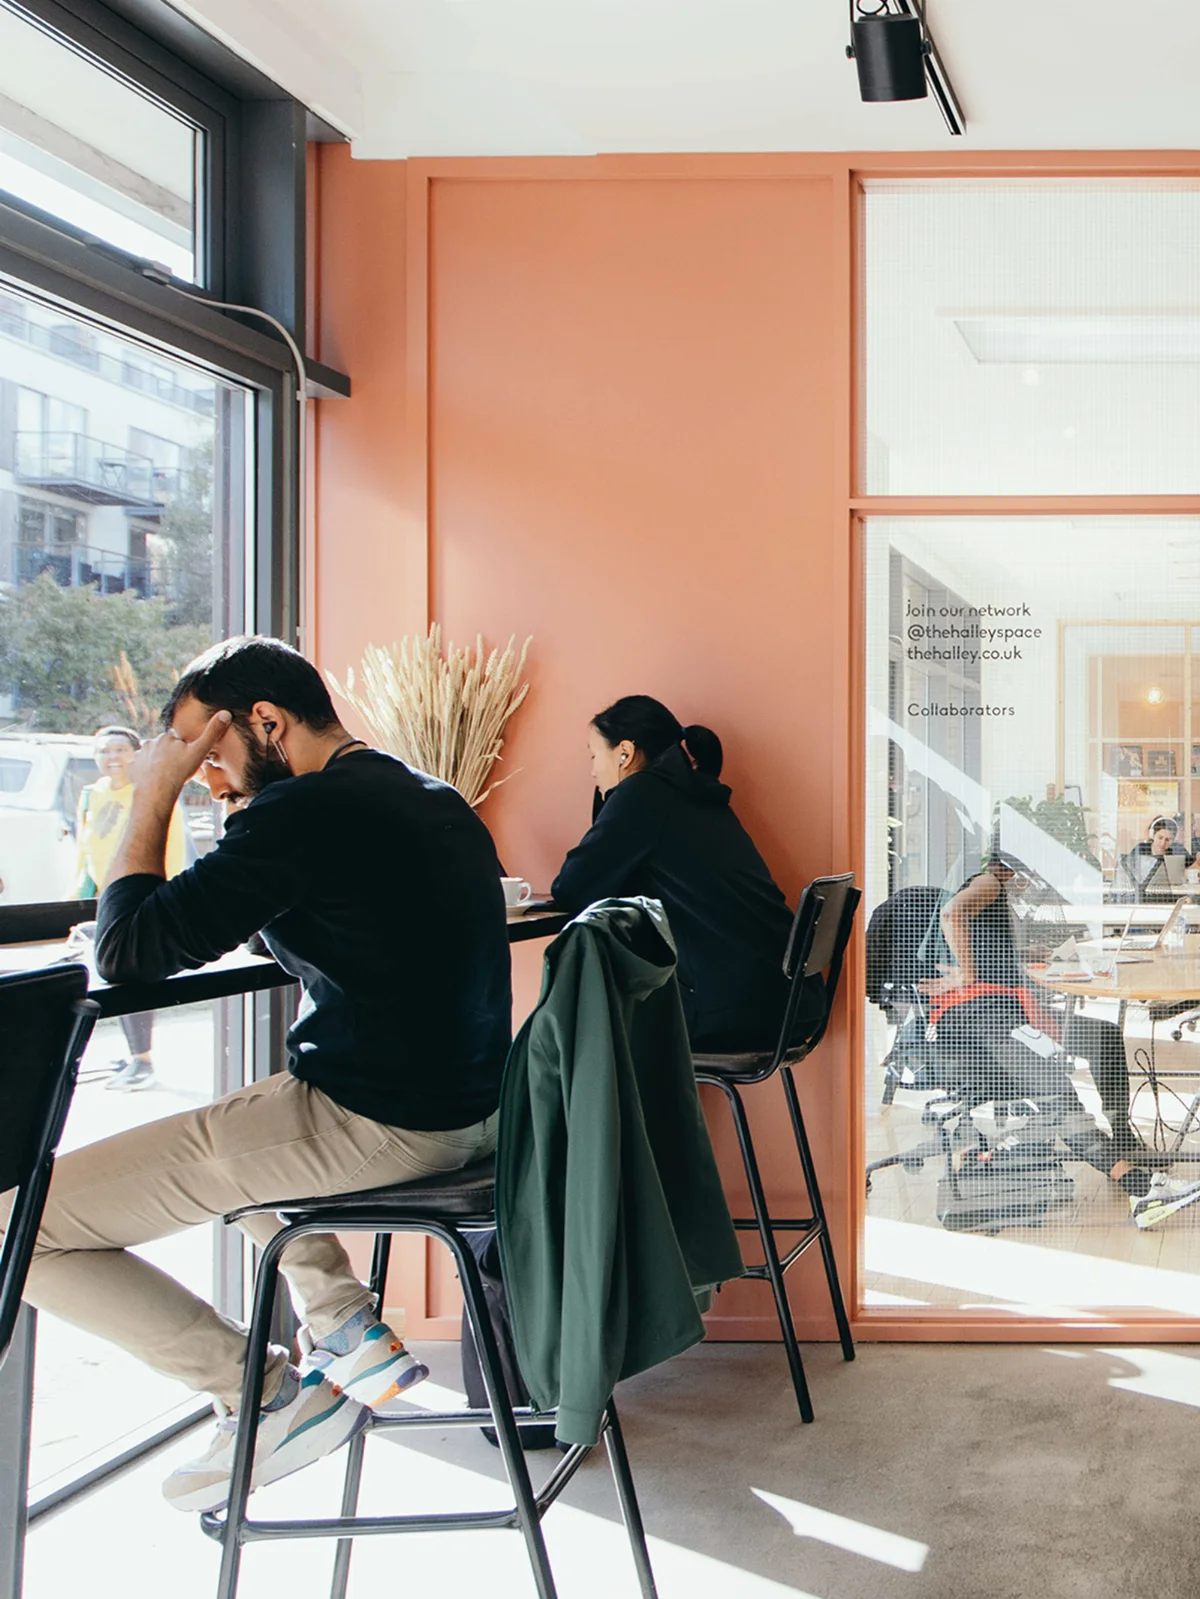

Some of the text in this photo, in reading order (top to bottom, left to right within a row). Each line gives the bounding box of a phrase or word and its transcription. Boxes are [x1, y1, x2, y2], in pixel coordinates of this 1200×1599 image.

[939, 606, 965, 617] our
[968, 602, 1031, 617] network
[907, 624, 1042, 642] @thehalleyspace
[907, 645, 1022, 664] thehalley.co.uk
[907, 702, 1016, 717] Collaborators
